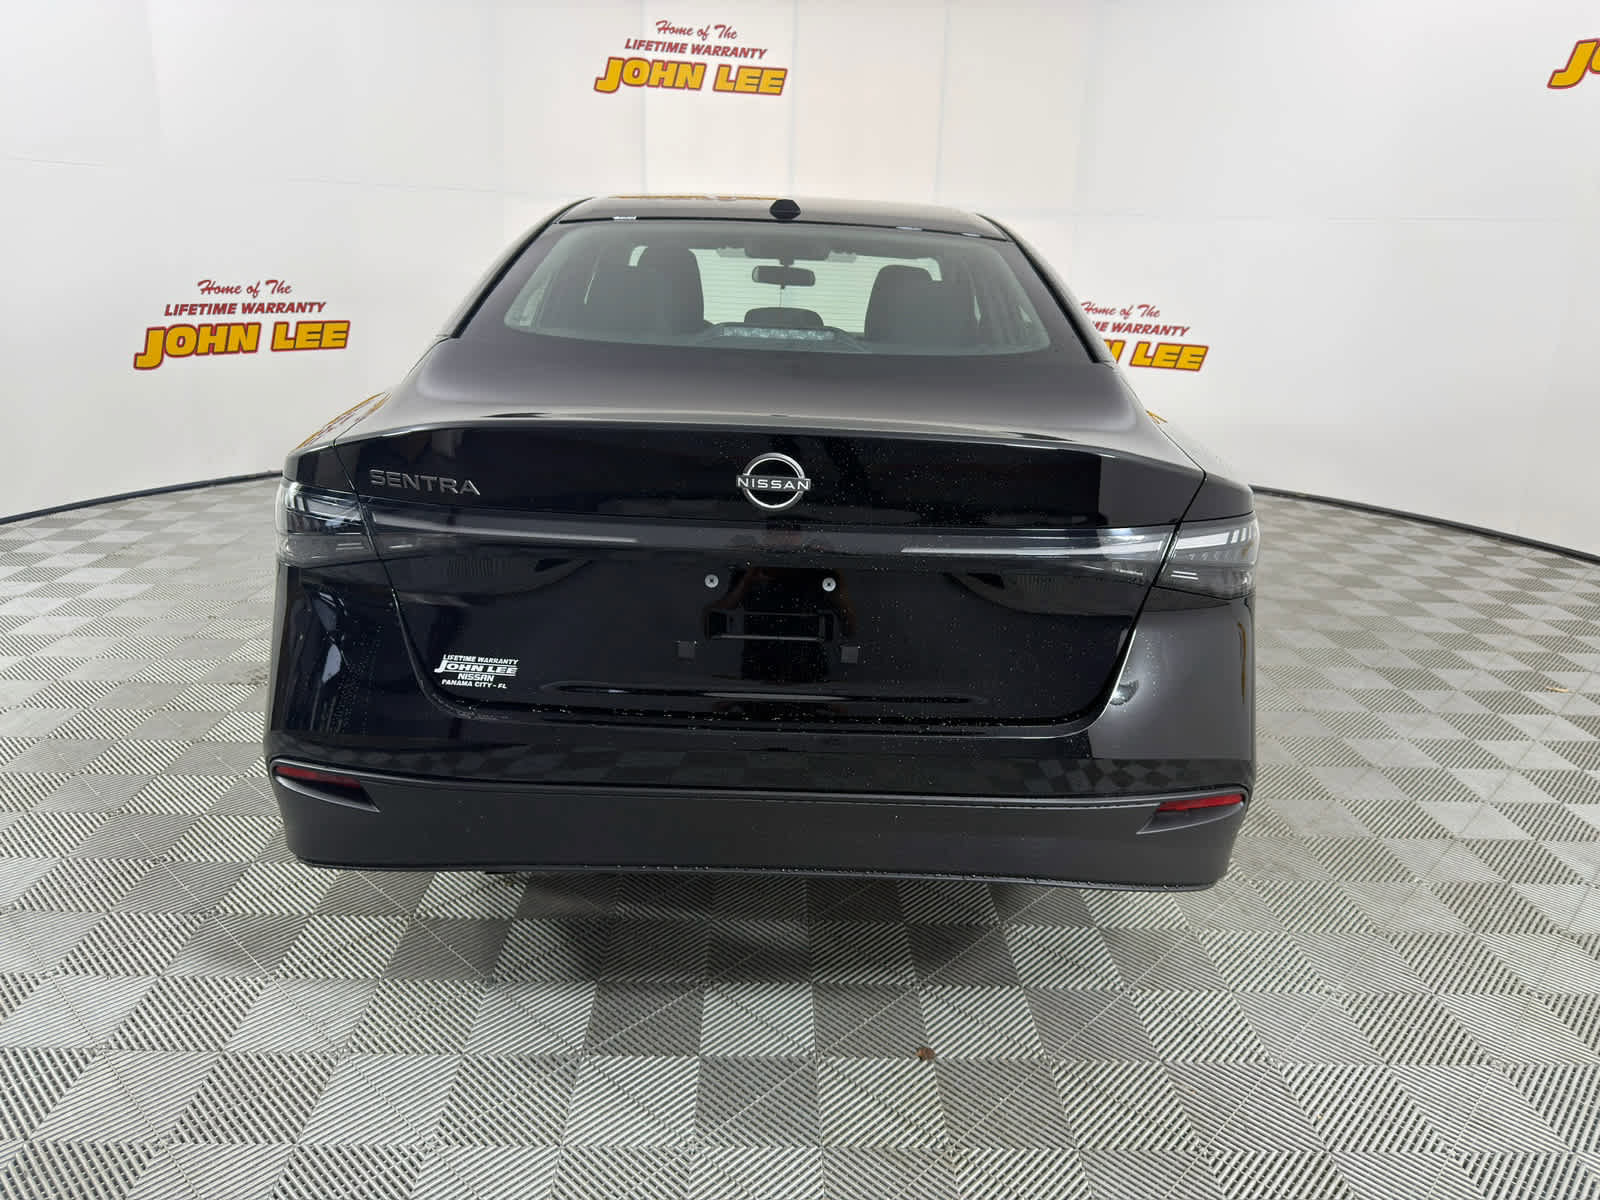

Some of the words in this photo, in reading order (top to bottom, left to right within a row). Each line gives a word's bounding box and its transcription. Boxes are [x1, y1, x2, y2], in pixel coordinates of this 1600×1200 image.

[656, 20, 693, 37] Home
[696, 25, 710, 41] of
[714, 24, 738, 39] The
[625, 38, 688, 54] LIFETIME
[691, 43, 767, 59] WARRANTY
[594, 56, 707, 94] JOHN
[713, 64, 788, 96] LEE
[198, 279, 242, 295] Home
[246, 280, 261, 298] of
[265, 279, 292, 295] The
[164, 303, 237, 316] LIFETIME
[241, 302, 326, 315] WARRANTY
[1081, 301, 1117, 316] Home
[1120, 305, 1134, 320] of
[1137, 304, 1161, 318] The
[1112, 322, 1190, 336] WARRANTY
[133, 321, 261, 370] JOHN
[271, 320, 350, 352] LEE
[1129, 341, 1209, 371] LEE
[369, 469, 480, 495] SENTRA
[737, 477, 809, 490] NISSAN
[434, 660, 484, 673] JOHN
[486, 665, 518, 674] LEE
[443, 654, 476, 662] LIFETIME
[477, 656, 518, 665] WARRANTY
[441, 679, 473, 687] PANAMA
[457, 673, 494, 681] NISSAN
